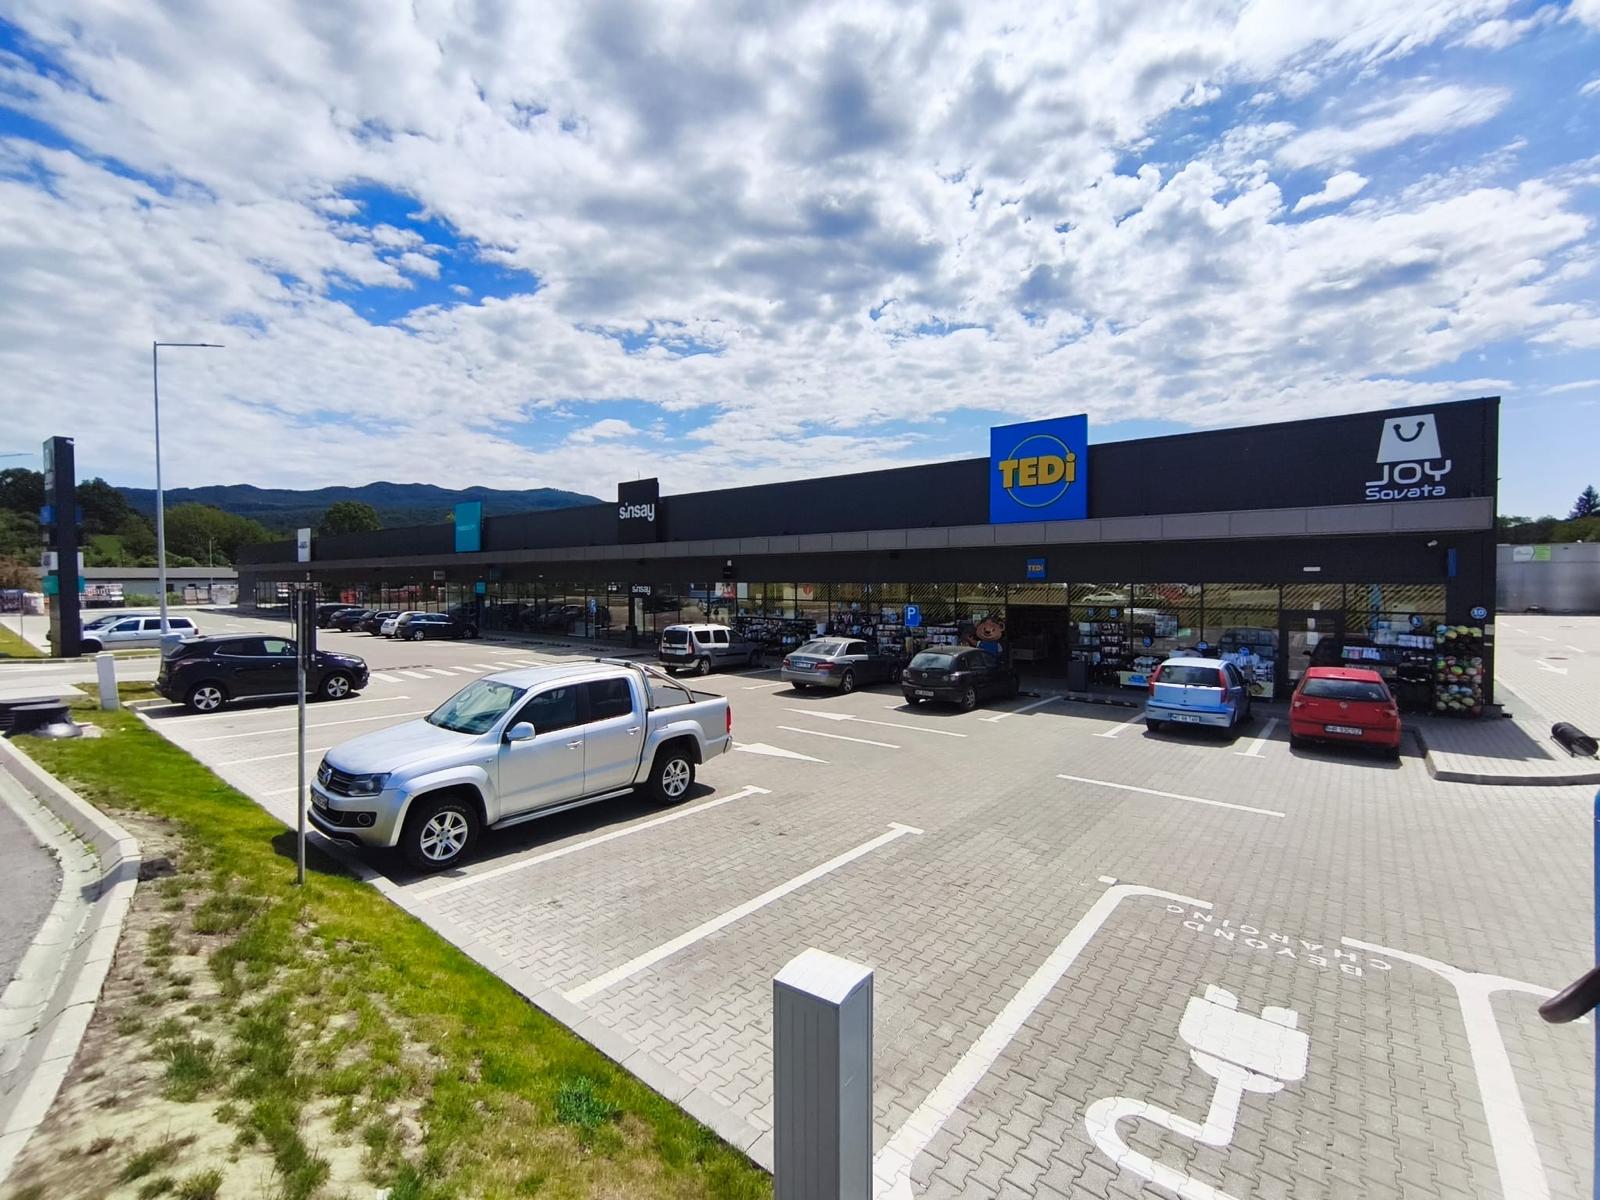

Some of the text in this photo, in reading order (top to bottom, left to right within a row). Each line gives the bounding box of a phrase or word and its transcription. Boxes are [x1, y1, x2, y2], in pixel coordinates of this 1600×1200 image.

[999, 452, 1076, 488] TEDi
[1365, 460, 1452, 486] JOY
[1365, 484, 1446, 500] Sovata
[619, 502, 656, 521] sinsay
[632, 584, 651, 596] sinsay
[907, 606, 916, 620] P
[1166, 905, 1392, 970] CHARGING
